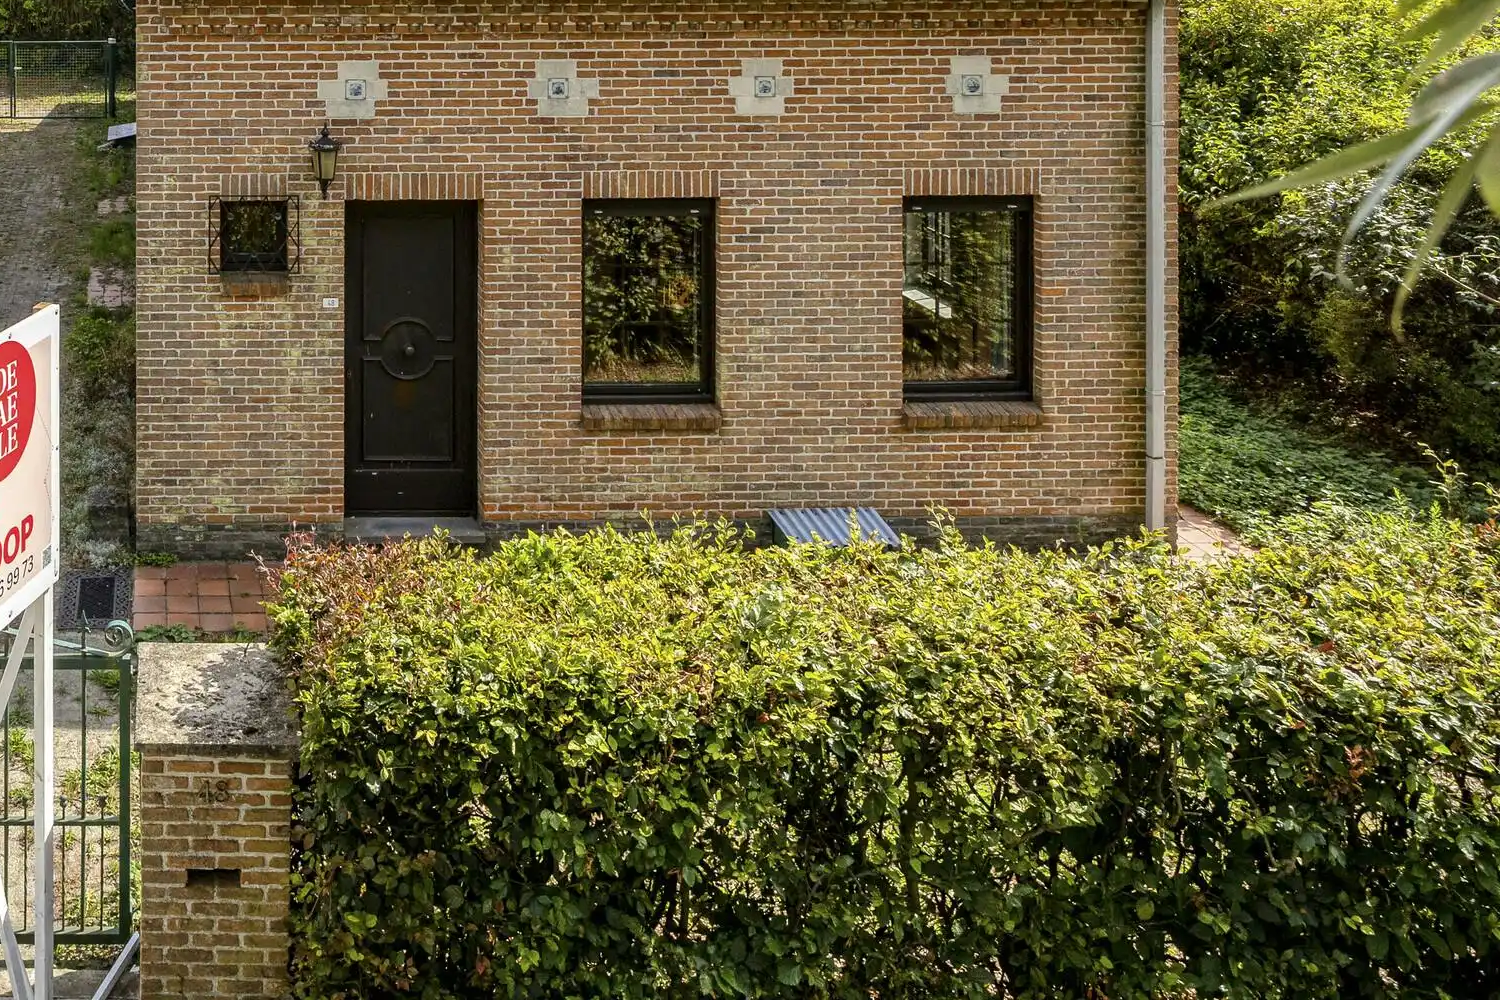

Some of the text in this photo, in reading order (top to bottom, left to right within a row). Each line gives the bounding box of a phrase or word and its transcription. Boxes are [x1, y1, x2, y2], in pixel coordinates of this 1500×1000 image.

[7, 567, 20, 591] 99
[22, 554, 34, 577] 73
[197, 779, 230, 802] 48
